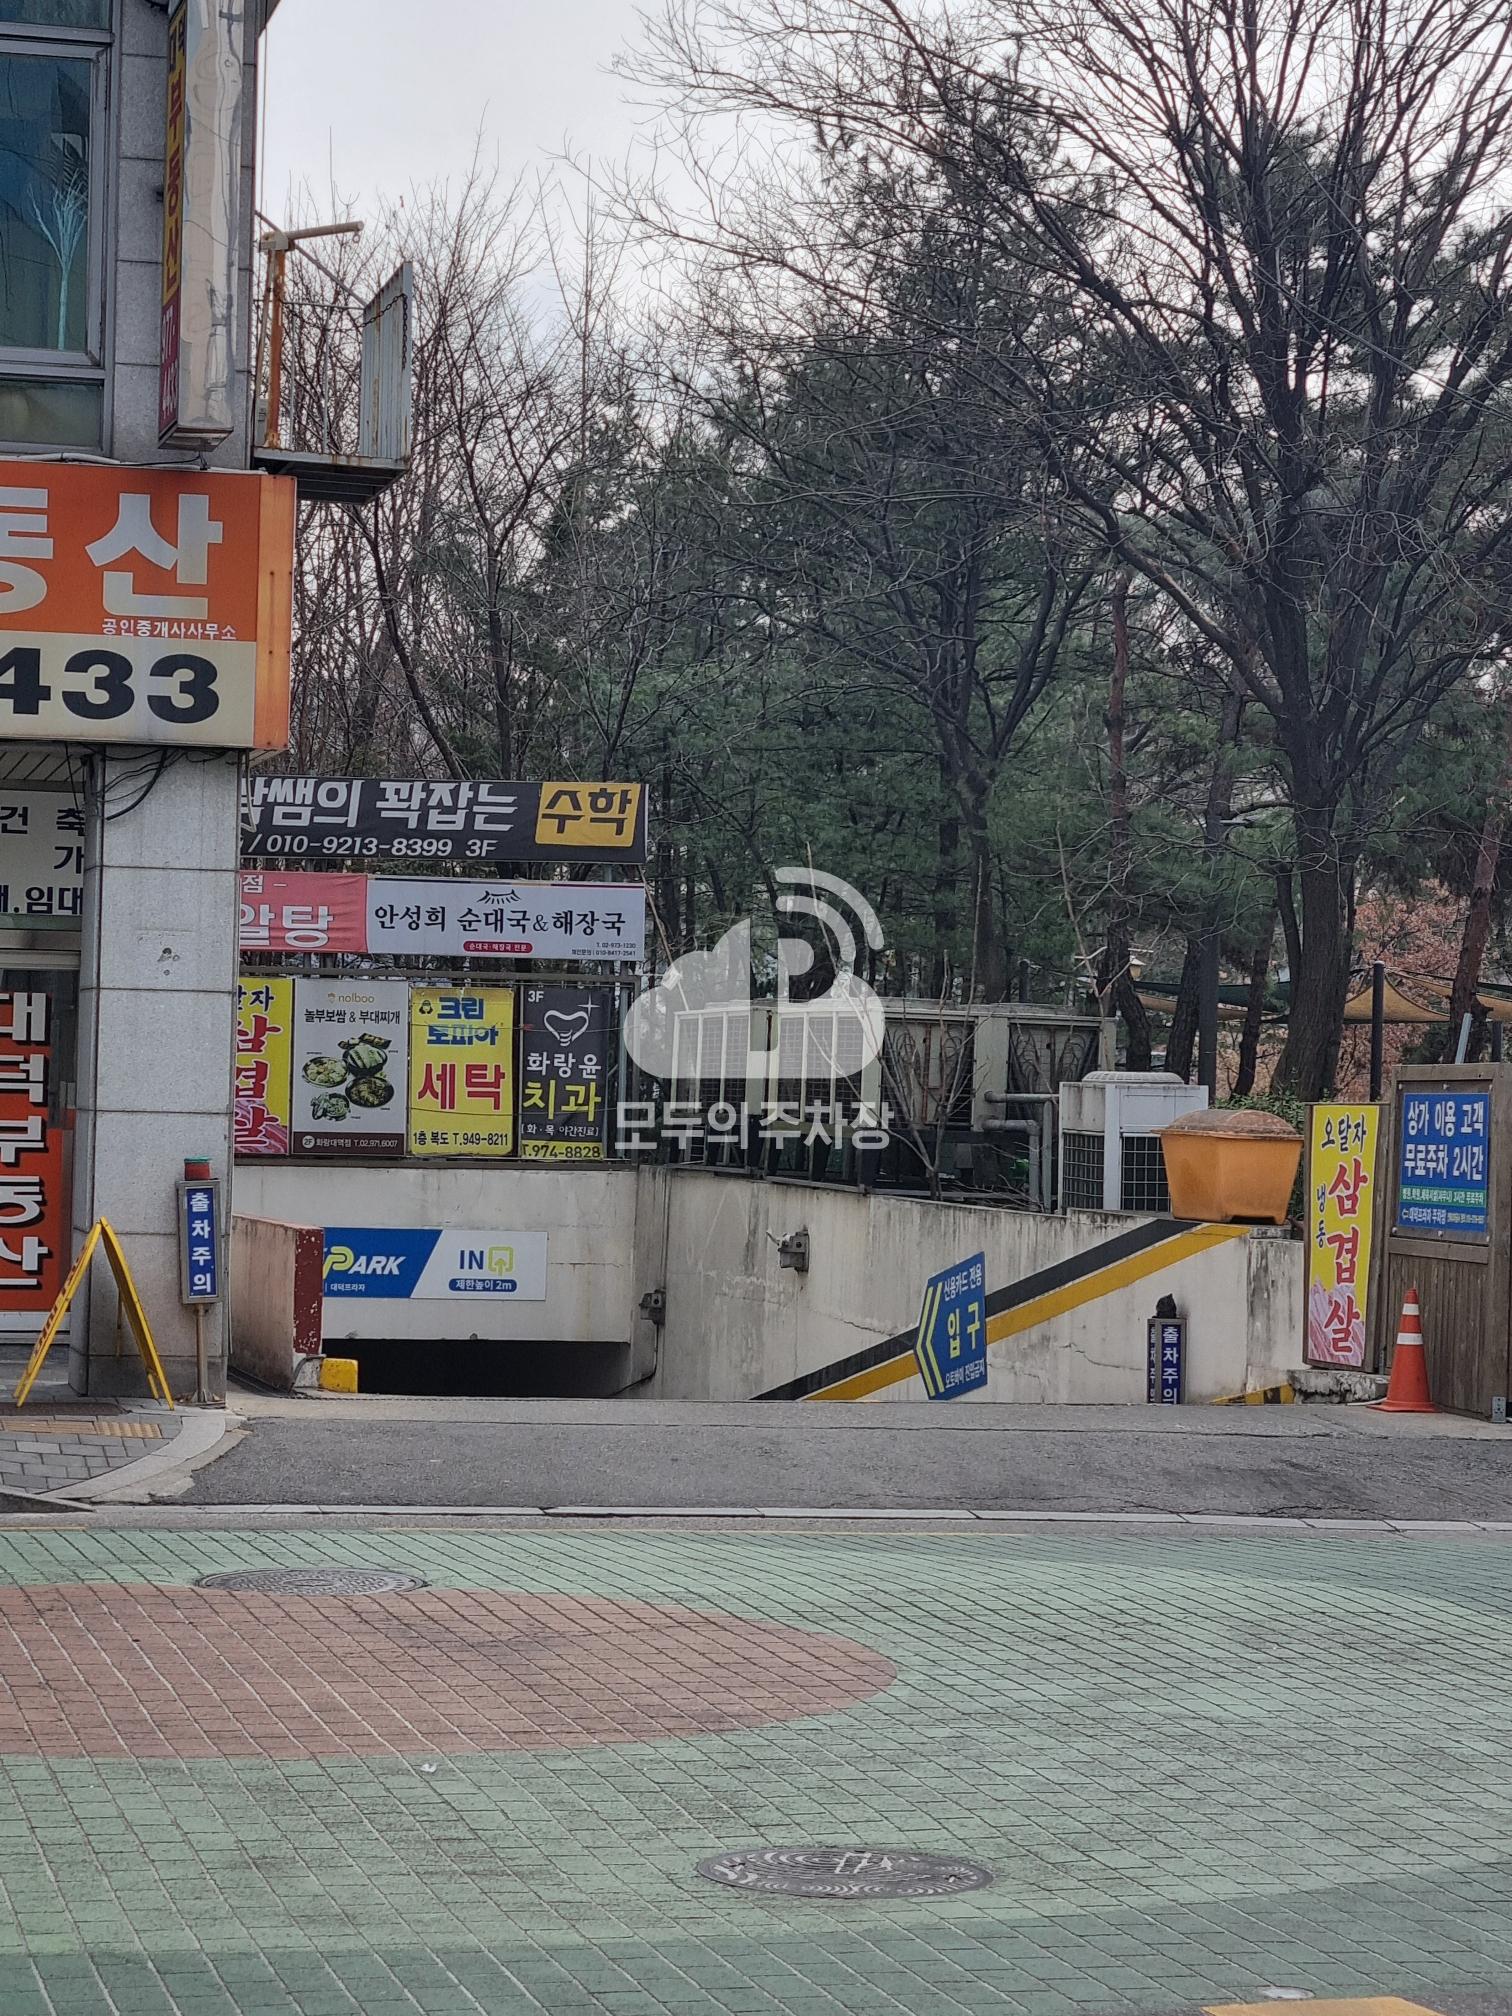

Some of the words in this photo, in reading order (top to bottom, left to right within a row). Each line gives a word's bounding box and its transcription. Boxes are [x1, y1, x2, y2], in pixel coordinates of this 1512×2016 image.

[166, 67, 183, 293] 부동산
[102, 618, 237, 640] 공인중개사사무소
[0, 647, 220, 724] 433
[376, 781, 518, 832] 꽉잡는
[541, 787, 633, 836] 수학
[266, 834, 453, 857] 010-9213-8399
[465, 838, 499, 858] 3F
[374, 904, 447, 932] 안성희
[456, 907, 626, 937] 순대국&해장국
[338, 992, 375, 1003] nolboo
[437, 996, 485, 1020] 크린
[528, 990, 544, 1003] 3F
[304, 1008, 346, 1023] 놀부보쌈
[348, 1011, 356, 1023] &
[359, 1010, 400, 1024] 부대찌개
[427, 1023, 499, 1046] 토피아
[526, 1051, 601, 1079] 화랑윤
[417, 1063, 506, 1111] 세탁
[523, 1079, 602, 1122] 치과
[1321, 1113, 1367, 1153] 오달자
[1407, 1100, 1430, 1136] 상가
[1434, 1100, 1456, 1137] 이용
[1460, 1101, 1484, 1137] 고객
[413, 1131, 427, 1146] 1층
[430, 1131, 450, 1146] 복도
[452, 1131, 509, 1147] T.949-8211
[522, 1143, 601, 1158] T.974-8828
[1404, 1143, 1449, 1180] 무료주차
[1452, 1144, 1484, 1181] 2시간
[1316, 1183, 1327, 1249] 냉동
[189, 1192, 212, 1294] 출차주의
[459, 1249, 484, 1270] IN
[1324, 1157, 1368, 1354] 삼겹살
[330, 1282, 366, 1292] 대덕프라자
[455, 1279, 494, 1290] 제한높이
[495, 1280, 512, 1290] 2m
[944, 1272, 969, 1301] 신용카드
[969, 1263, 982, 1289] 전용
[947, 1301, 981, 1359] 입구
[945, 1366, 965, 1389] 오토바이
[965, 1358, 985, 1381] 진입금지
[1162, 1326, 1179, 1405] 출차주의
